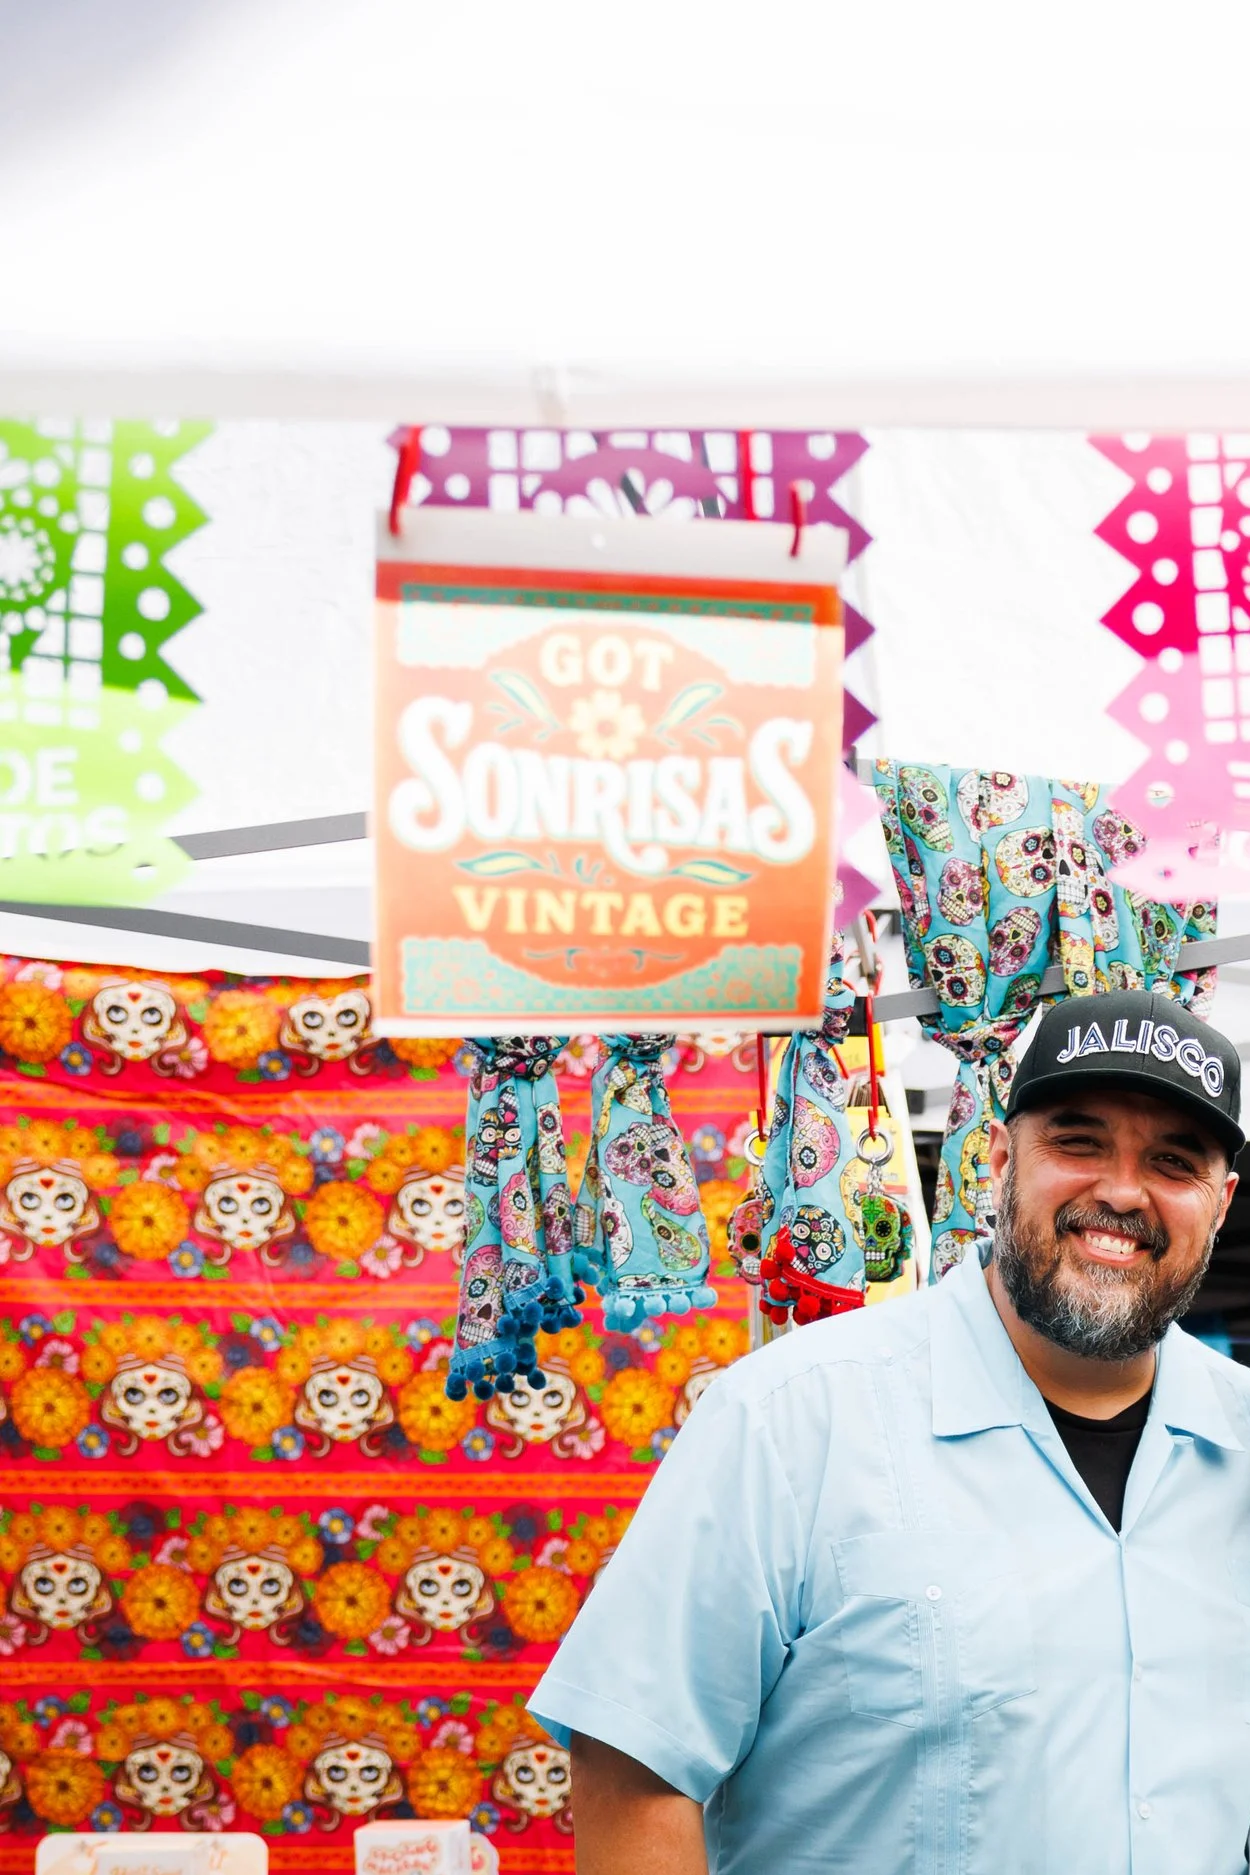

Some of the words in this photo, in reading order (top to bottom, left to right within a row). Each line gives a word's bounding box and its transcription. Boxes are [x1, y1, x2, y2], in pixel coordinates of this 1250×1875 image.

[540, 633, 674, 691] GOT
[388, 696, 816, 874] SONRISAS
[452, 885, 750, 938] VINTAGE
[1056, 1019, 1225, 1098] JALISCO
